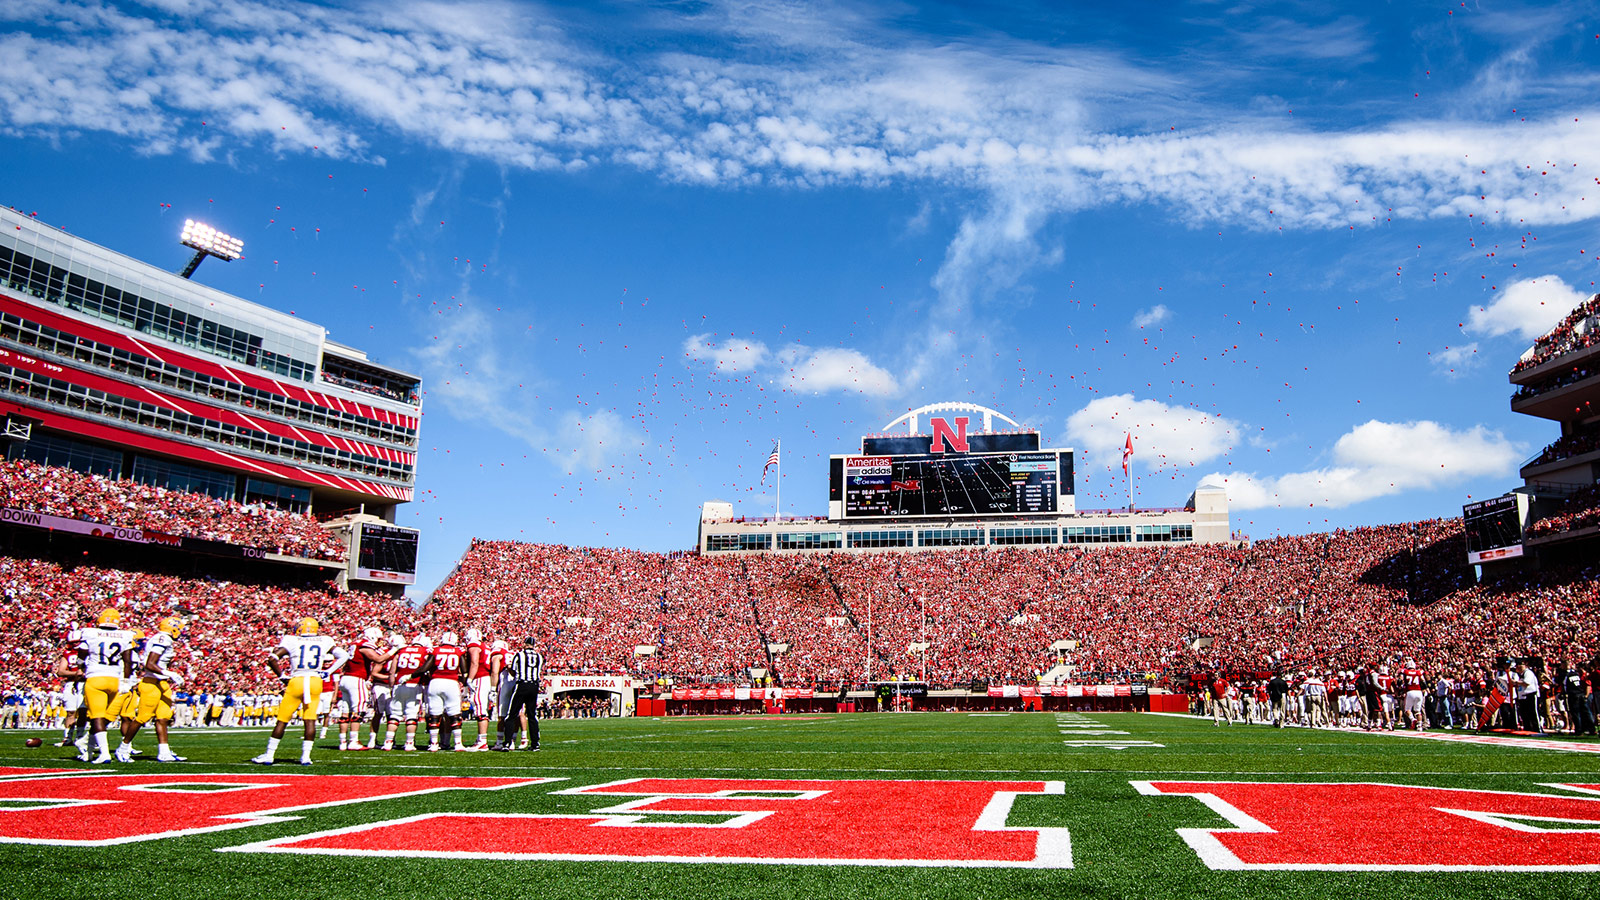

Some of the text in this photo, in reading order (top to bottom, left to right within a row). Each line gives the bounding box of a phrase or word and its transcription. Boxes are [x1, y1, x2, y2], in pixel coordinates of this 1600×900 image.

[17, 355, 37, 365] 1997
[930, 416, 970, 454] N
[847, 458, 890, 466] Ameritas
[861, 466, 891, 475] adidas
[2, 509, 42, 526] DOWN
[112, 527, 183, 547] TOUCN
[158, 635, 165, 643] 6
[98, 641, 122, 666] 12
[297, 644, 321, 669] 13
[398, 652, 422, 670] 65
[435, 653, 460, 671] 70
[544, 679, 553, 688] N
[560, 679, 616, 688] NEBRASKA
[624, 679, 632, 688] N
[1405, 675, 1420, 686] 74
[891, 687, 924, 695] CeturyLink
